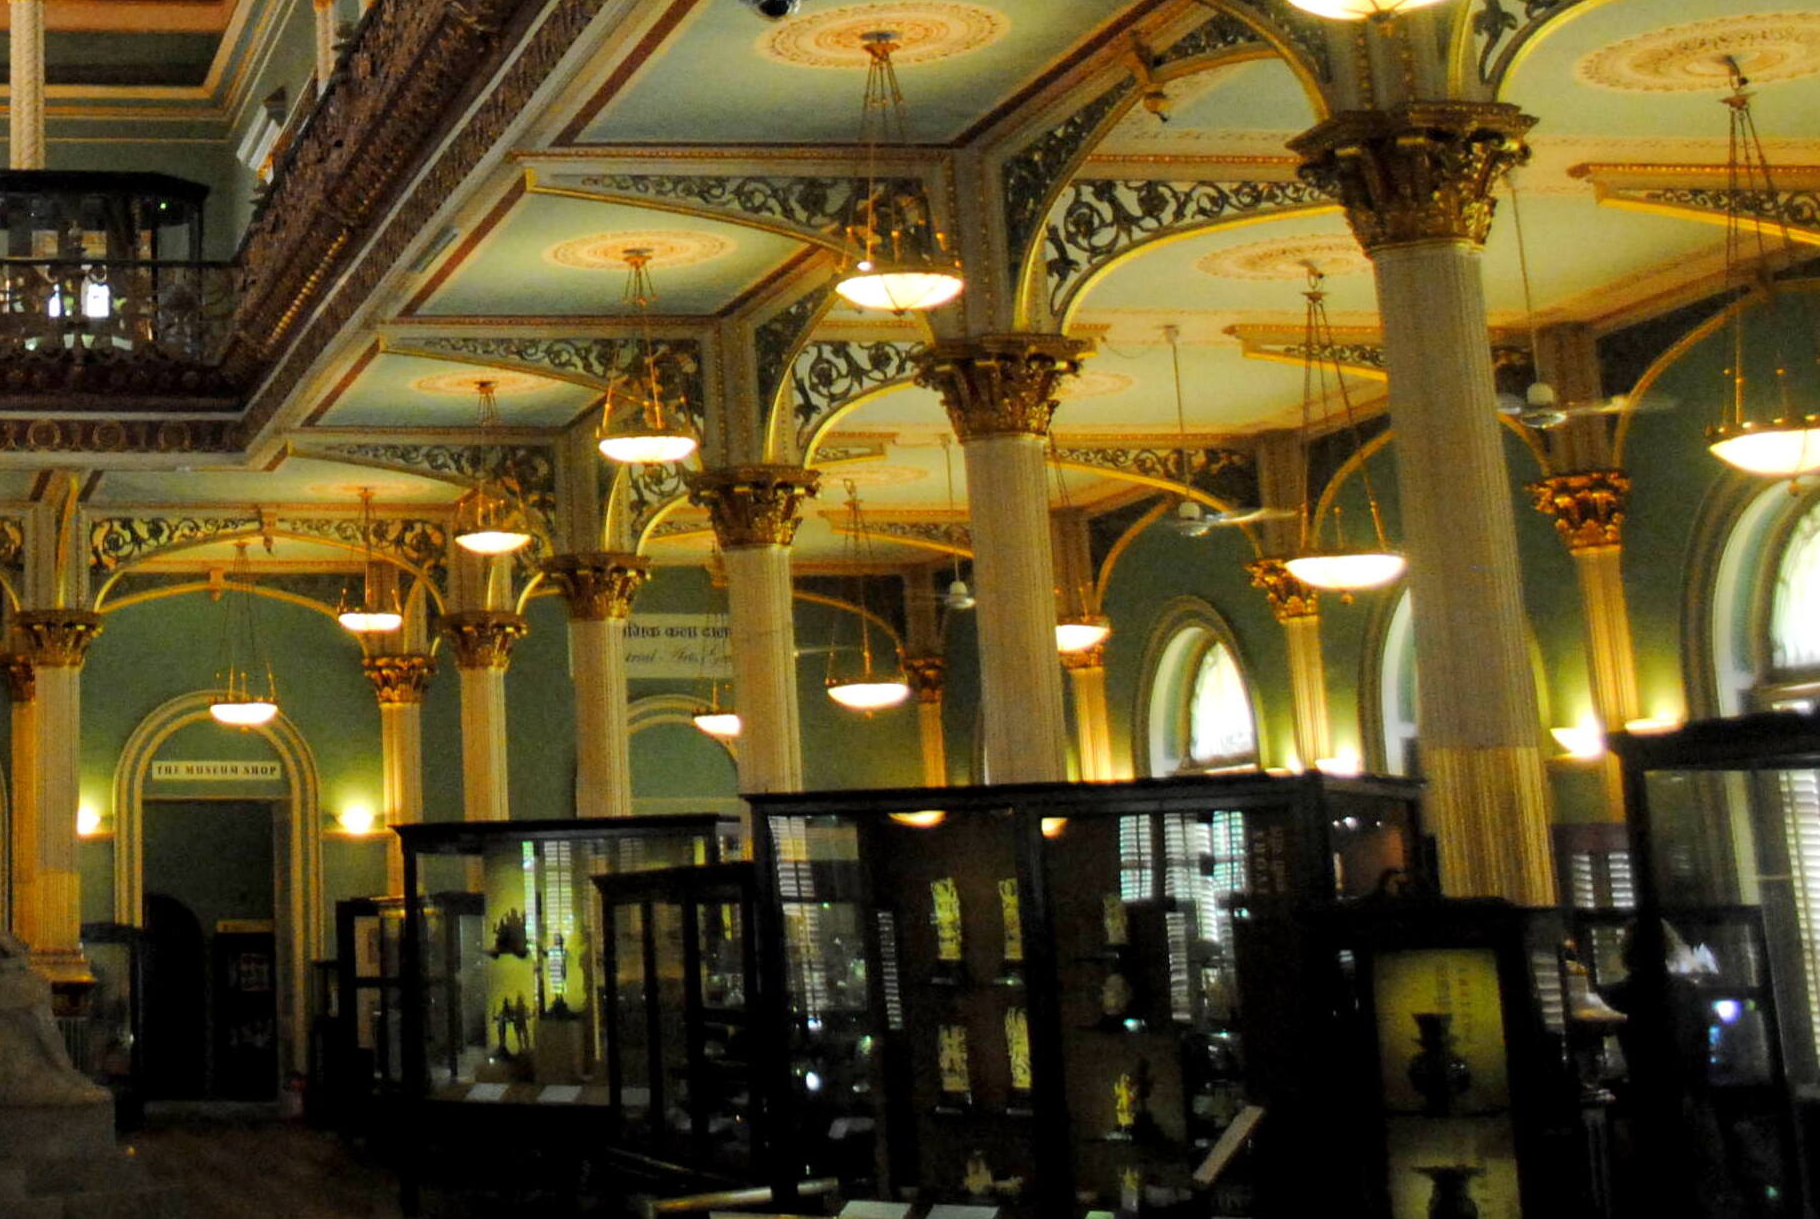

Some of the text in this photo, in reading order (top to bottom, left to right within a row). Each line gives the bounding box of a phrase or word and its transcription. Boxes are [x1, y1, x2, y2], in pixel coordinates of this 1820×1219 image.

[157, 765, 277, 775] THE MUSEUM SHOP
